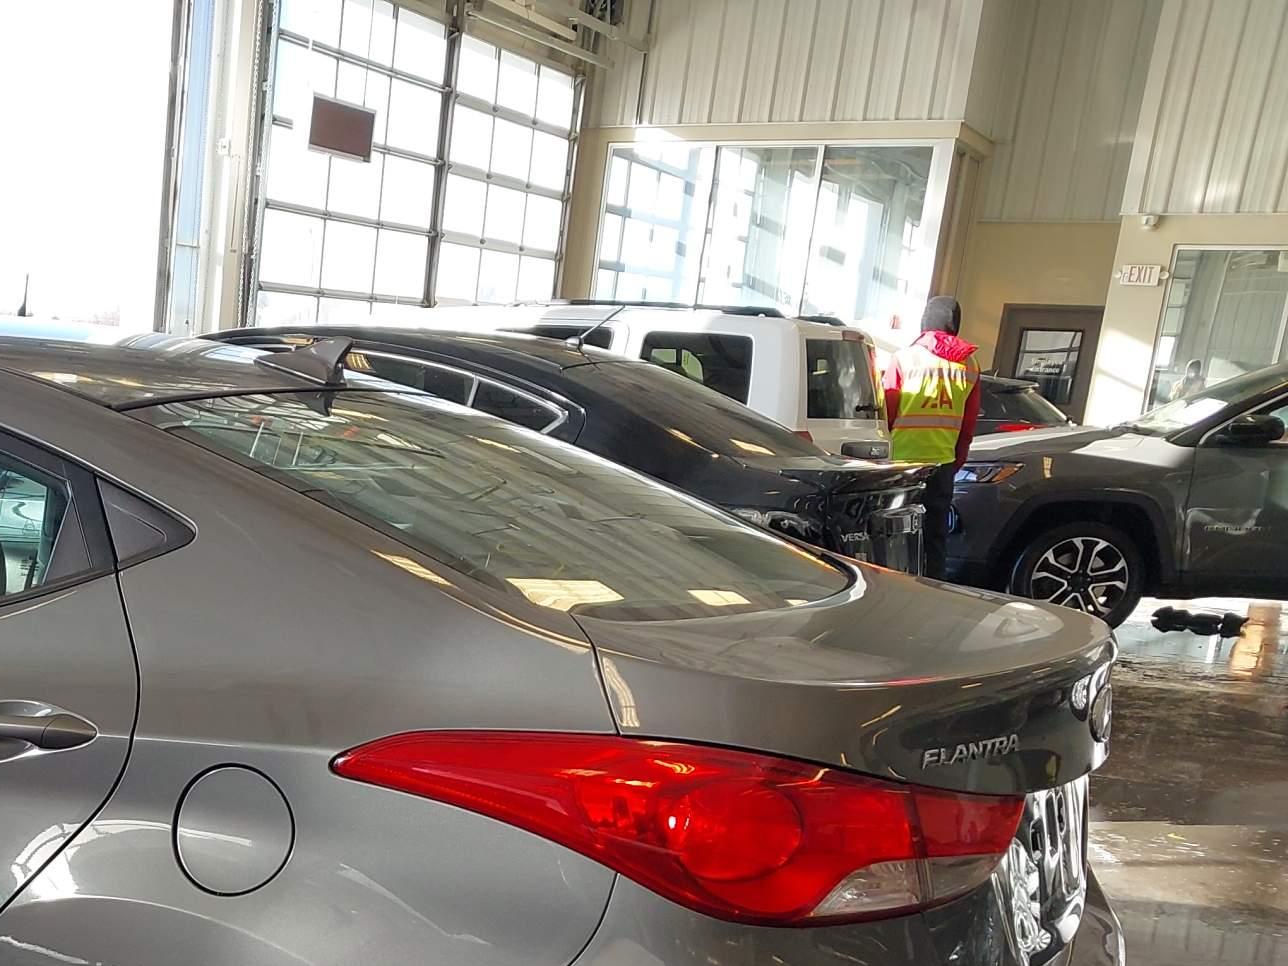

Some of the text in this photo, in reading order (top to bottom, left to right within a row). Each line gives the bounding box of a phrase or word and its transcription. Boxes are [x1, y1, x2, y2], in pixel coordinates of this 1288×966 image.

[1128, 265, 1155, 283] EXIT
[840, 531, 870, 543] VERSA
[921, 734, 1020, 770] ELANTRA
